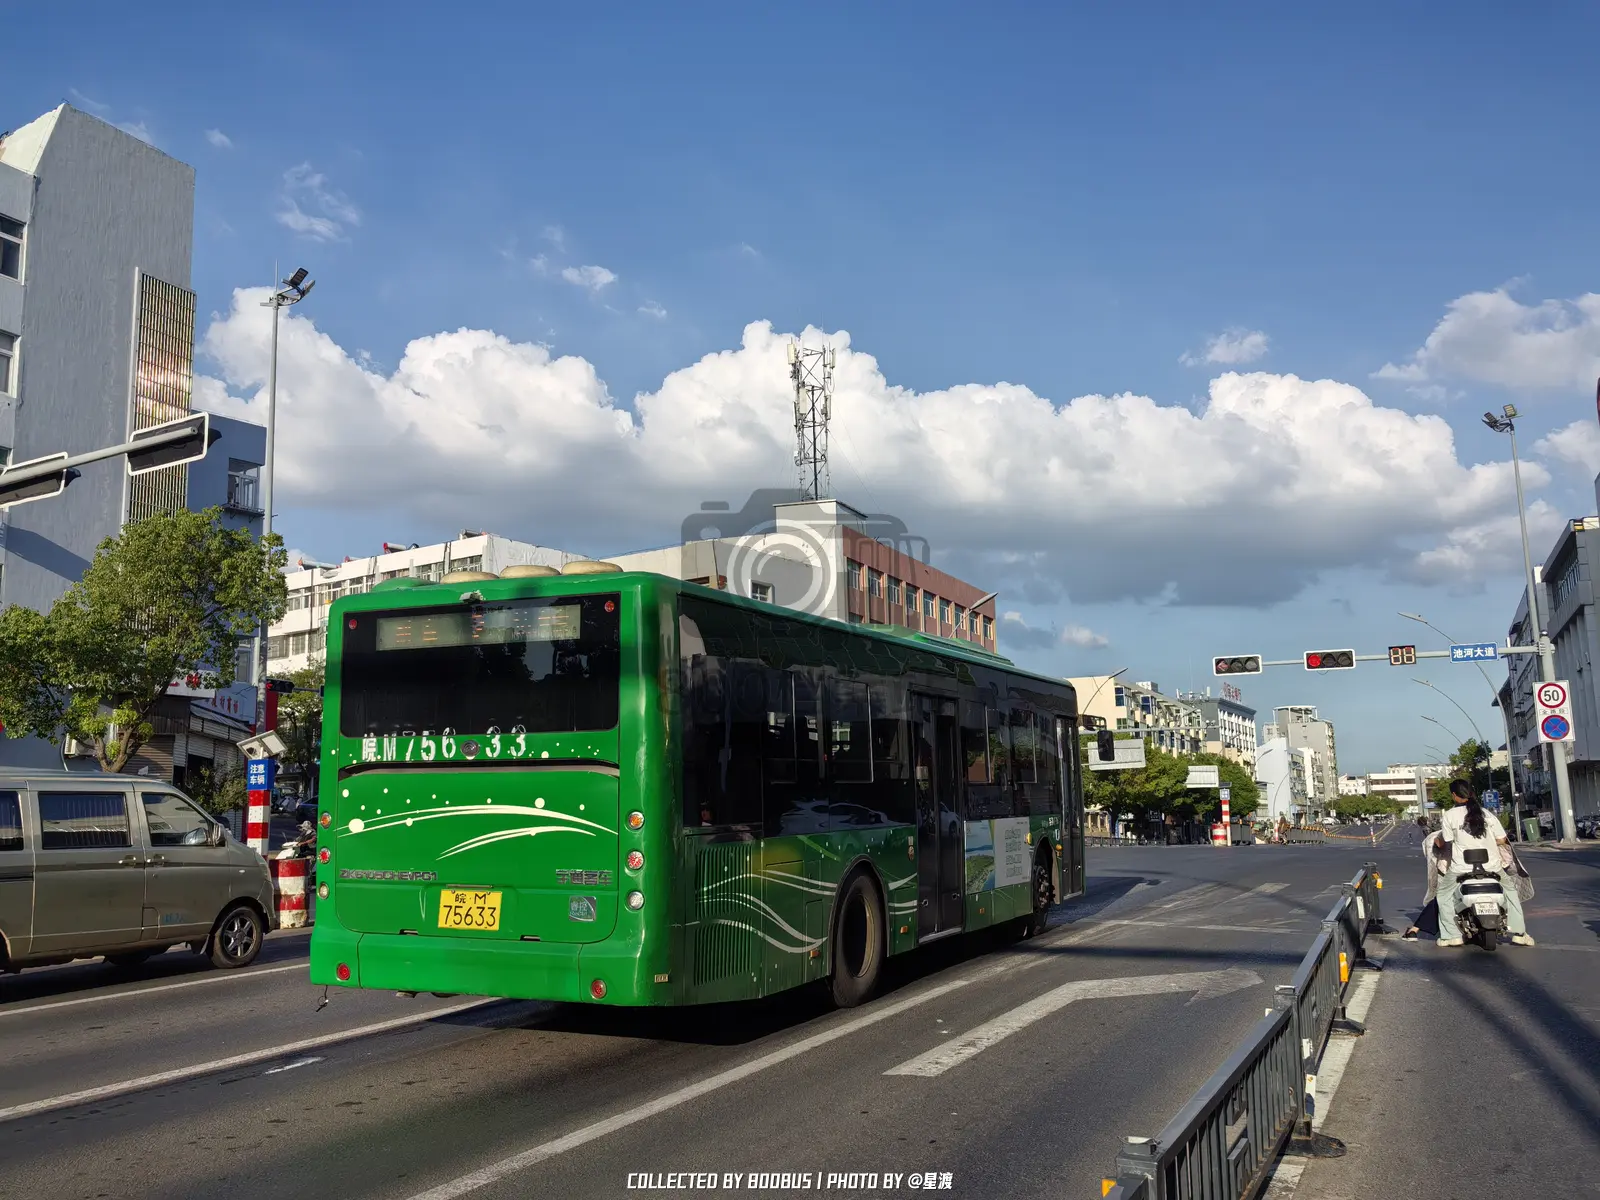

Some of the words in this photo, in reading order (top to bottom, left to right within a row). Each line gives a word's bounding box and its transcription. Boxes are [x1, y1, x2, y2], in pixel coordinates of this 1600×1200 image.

[1453, 646, 1495, 659] 池河大道
[1544, 690, 1560, 702] 50
[250, 764, 265, 774] 注意
[443, 905, 496, 927] 75633
